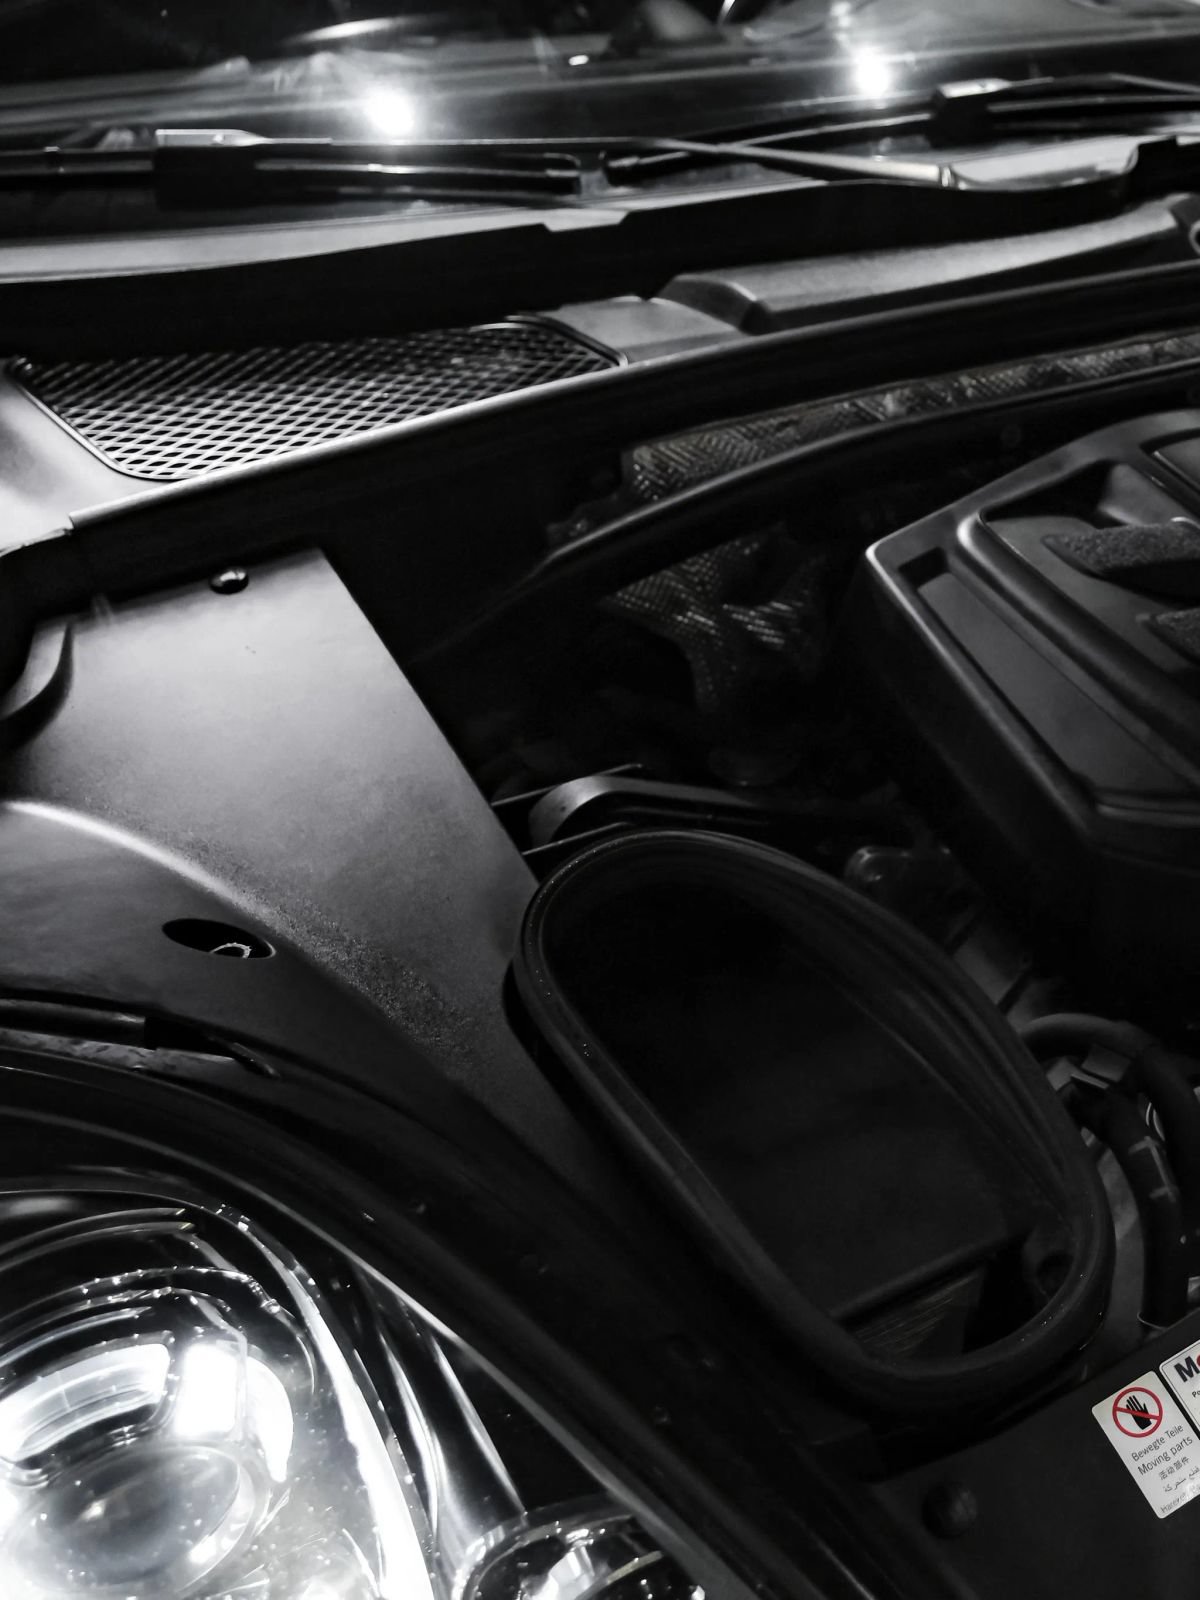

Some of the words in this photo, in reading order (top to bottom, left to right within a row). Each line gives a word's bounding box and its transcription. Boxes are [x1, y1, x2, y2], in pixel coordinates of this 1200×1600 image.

[1131, 1437, 1166, 1462] Bewegte
[1164, 1425, 1184, 1439] Teile
[1137, 1451, 1171, 1475] Moving
[1170, 1436, 1193, 1455] parts
